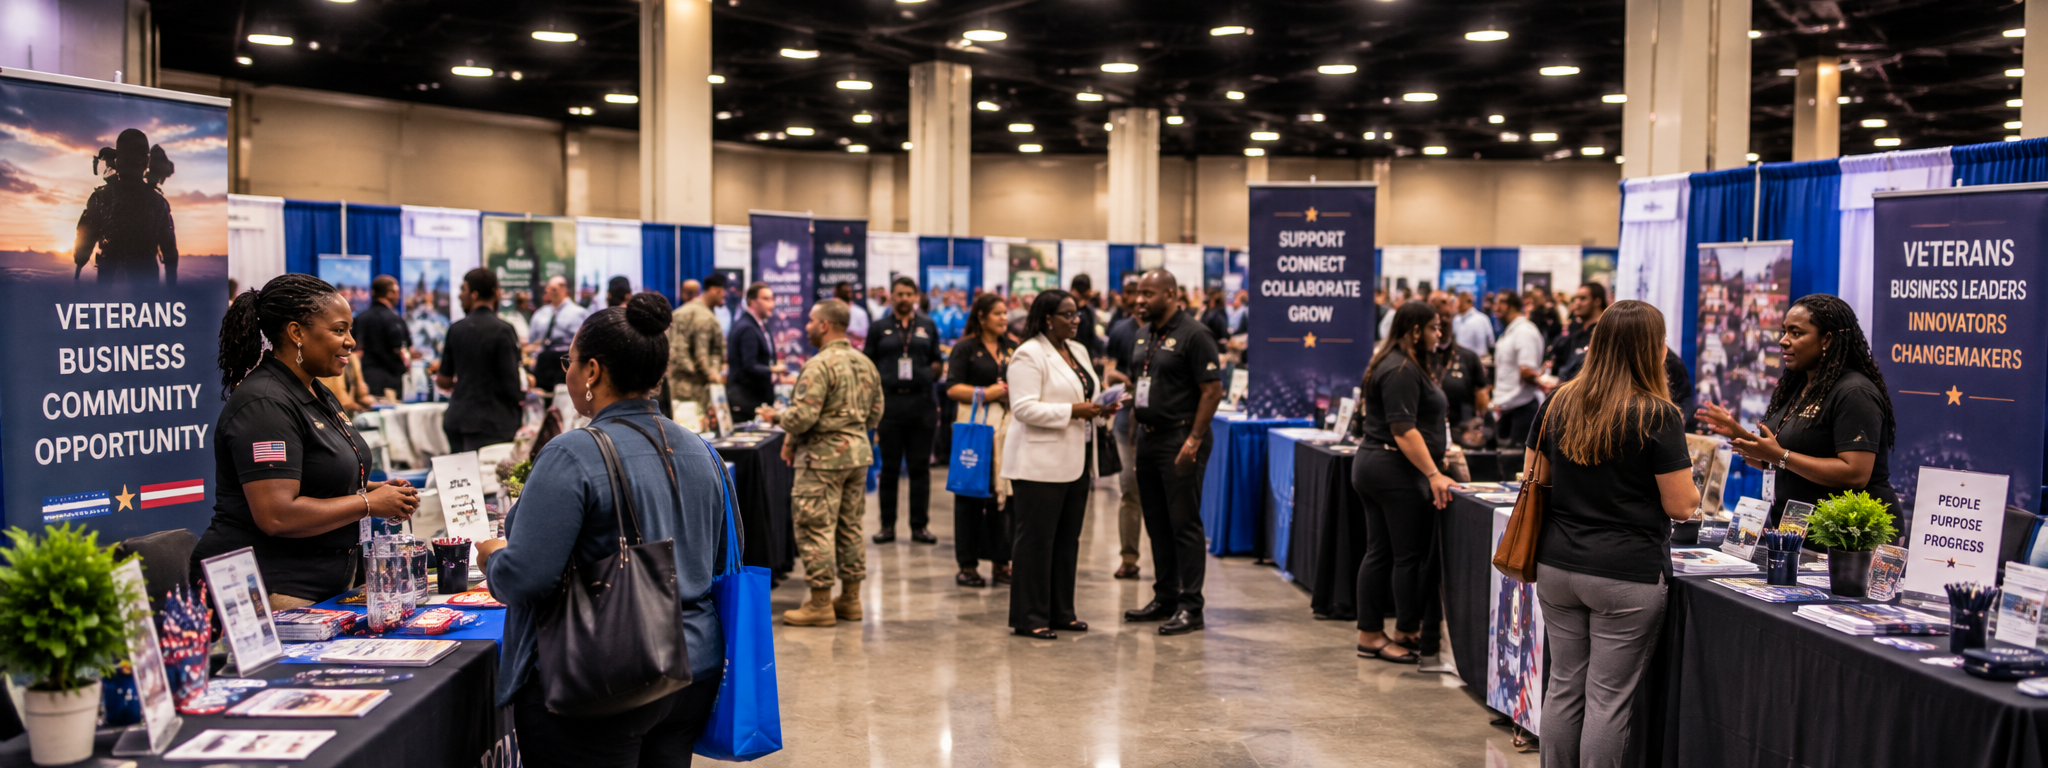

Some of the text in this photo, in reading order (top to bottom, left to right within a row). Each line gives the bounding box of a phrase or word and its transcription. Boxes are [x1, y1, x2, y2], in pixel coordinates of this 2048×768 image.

[1279, 230, 1346, 248] SUPPORT
[1903, 238, 2015, 267] VETERANS
[1277, 255, 1346, 273] CONNECT
[1261, 279, 1361, 298] COLLABORATE
[1890, 279, 2027, 300] BUSINESS LEADERS
[55, 301, 187, 330] VETERANS
[1288, 305, 1334, 322] GROW
[1908, 311, 2007, 334] INNOVATORS
[59, 342, 186, 375] BUSINESS
[1891, 343, 2022, 370] CHANGEMAKERS
[42, 383, 202, 420] COMMUNITY
[34, 423, 209, 466] OPPORTUNITY
[1938, 494, 1981, 511] PEOPLE
[1930, 514, 1983, 532] PURPOSE
[1923, 533, 1984, 554] PROGRESS
